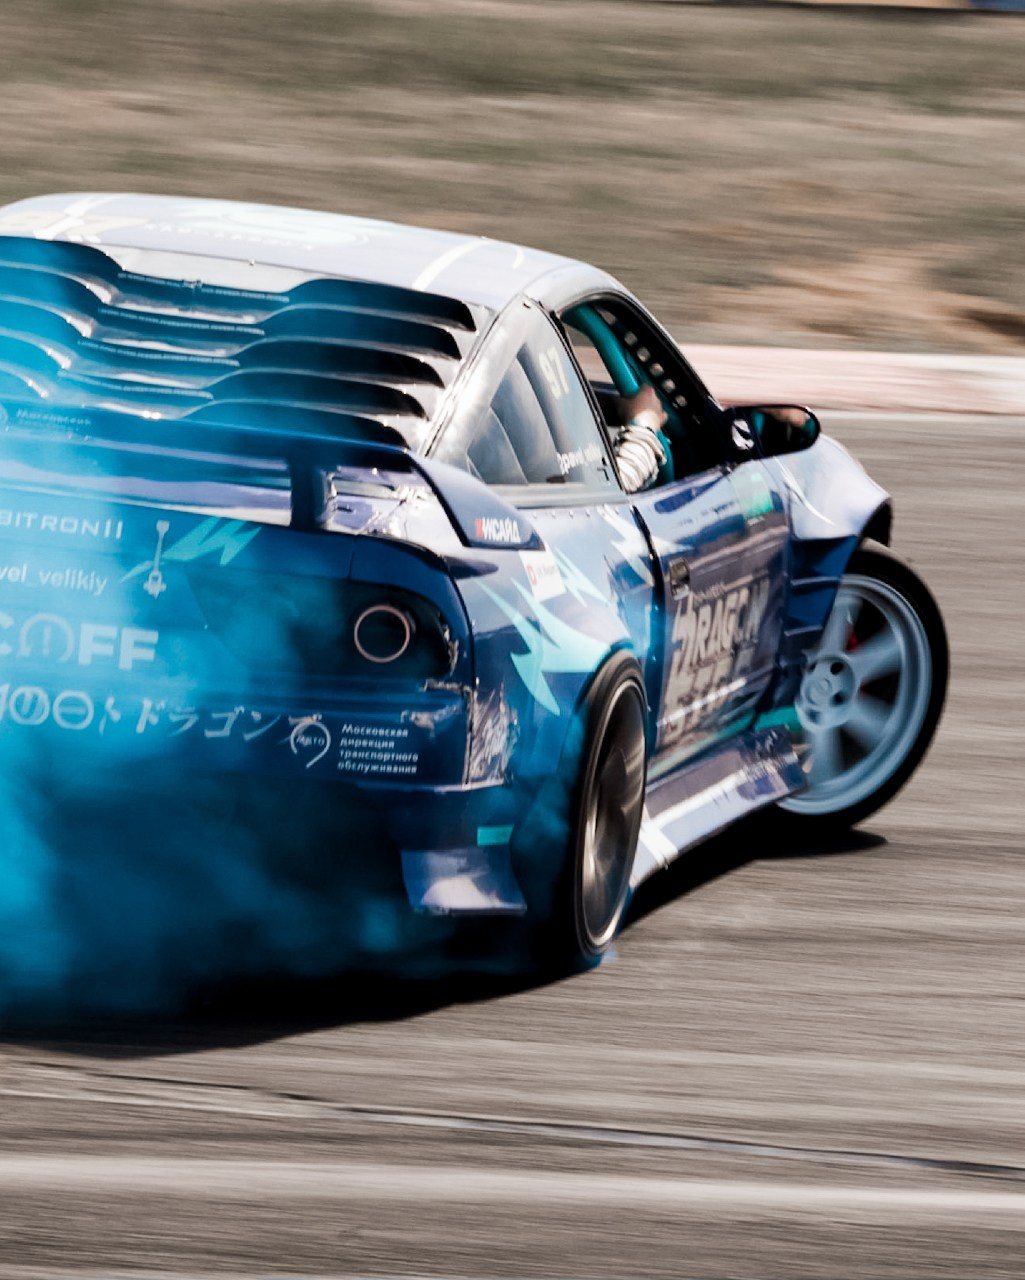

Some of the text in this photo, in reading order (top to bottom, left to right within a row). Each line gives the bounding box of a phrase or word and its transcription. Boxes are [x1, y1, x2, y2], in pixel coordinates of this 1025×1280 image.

[538, 346, 570, 399] 97
[341, 723, 409, 738] Московская
[340, 738, 395, 749] дирекция
[339, 749, 419, 762] транспортного
[337, 760, 418, 774] обслуживания
